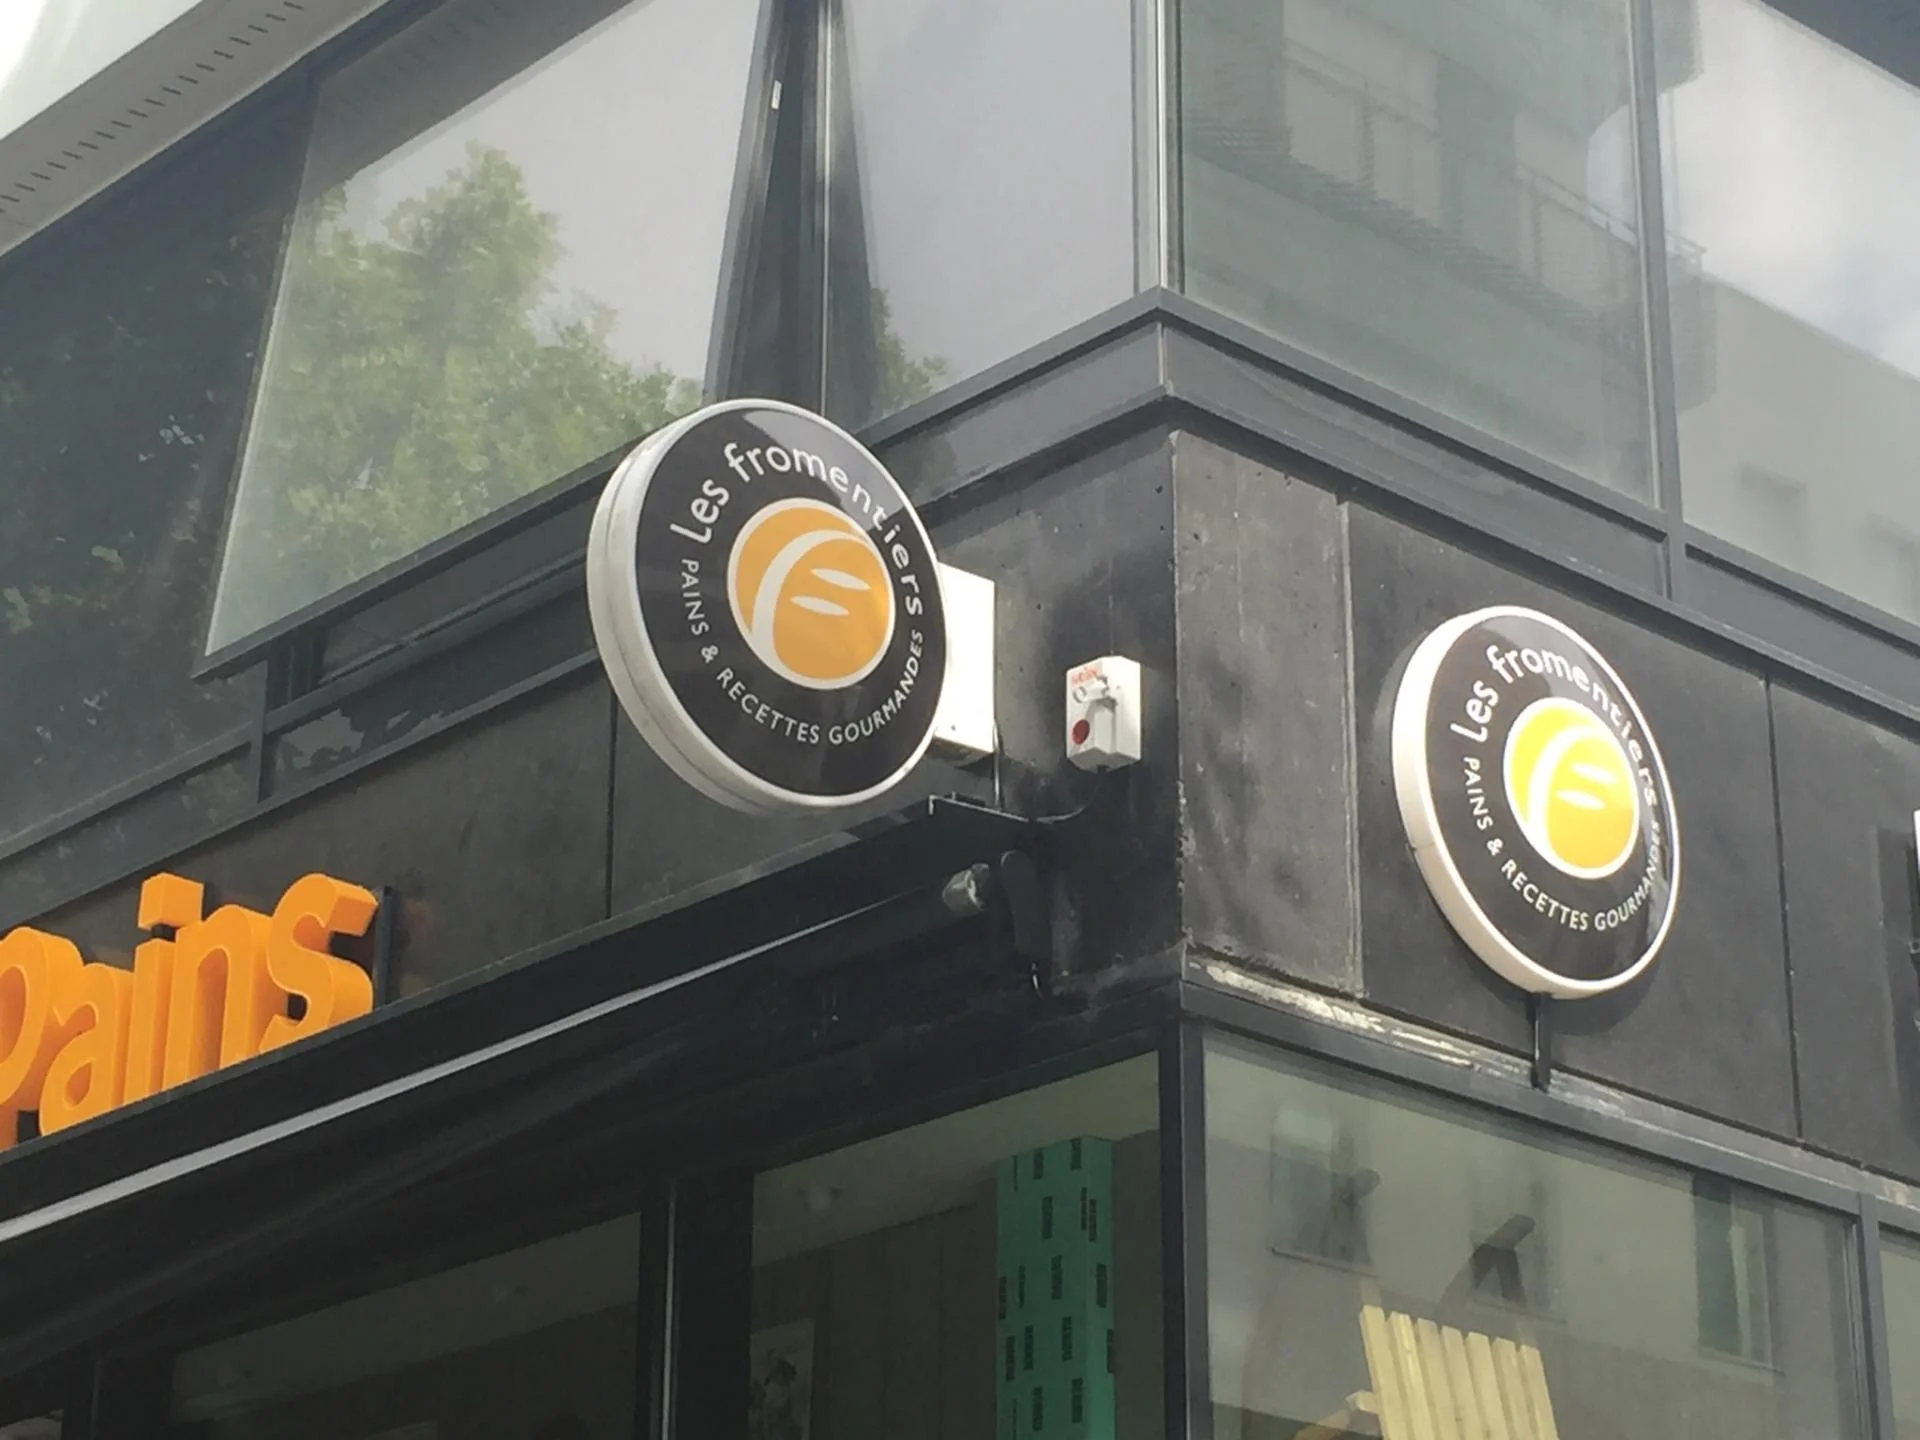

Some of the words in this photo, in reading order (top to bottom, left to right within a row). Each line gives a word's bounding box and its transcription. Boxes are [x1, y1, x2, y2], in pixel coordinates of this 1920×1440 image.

[670, 479, 730, 545] Les
[723, 442, 923, 617] fromentiers
[681, 558, 710, 637] PAINS
[701, 645, 719, 664] &
[716, 668, 821, 745] RECETTES
[829, 629, 924, 746] GOURMANDES
[1450, 679, 1500, 743] Les
[1485, 644, 1659, 808] fromentiers
[1463, 756, 1494, 832] PAINS
[1486, 839, 1504, 857] &
[1501, 860, 1590, 932] RECETTES
[1594, 819, 1661, 932] GOURMANDES
